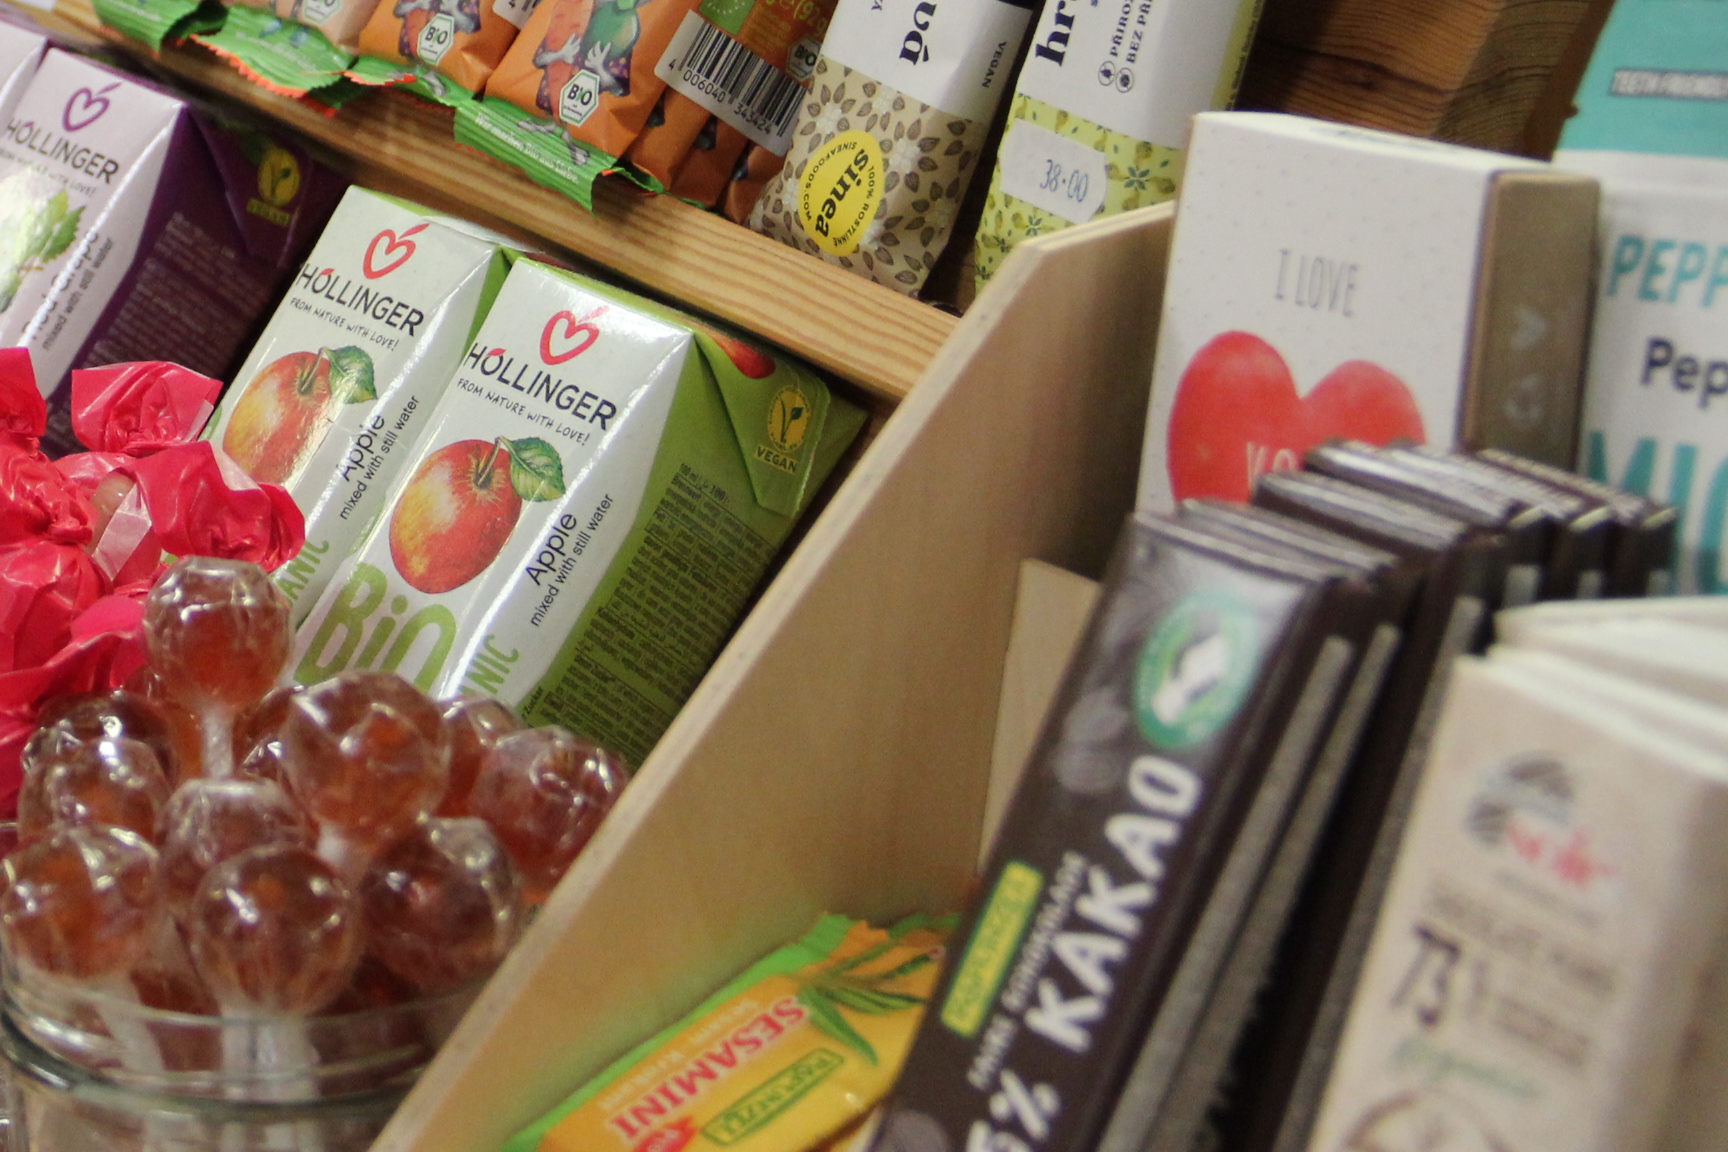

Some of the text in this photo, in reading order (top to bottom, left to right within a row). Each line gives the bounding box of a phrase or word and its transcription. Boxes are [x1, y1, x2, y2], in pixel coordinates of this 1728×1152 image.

[980, 38, 1007, 90] VEGAN
[1124, 26, 1143, 64] BEZ
[682, 68, 773, 136] 006040 343424
[803, 141, 858, 221] SINEAFOODS.COM
[815, 148, 869, 237] sinea
[1275, 249, 1359, 320] I LOVE
[314, 307, 400, 351] NATURE WITH LOVE!
[456, 378, 590, 446] FROM NATURE WITH LOVE!
[339, 414, 386, 482] Apple
[339, 395, 420, 521] mixed with still water
[757, 446, 798, 472] VEGAN
[525, 513, 578, 587] Apple
[530, 493, 614, 627] mixed with still water
[1025, 755, 1205, 1054] KAKAO
[610, 994, 810, 1138] SESAMINI
